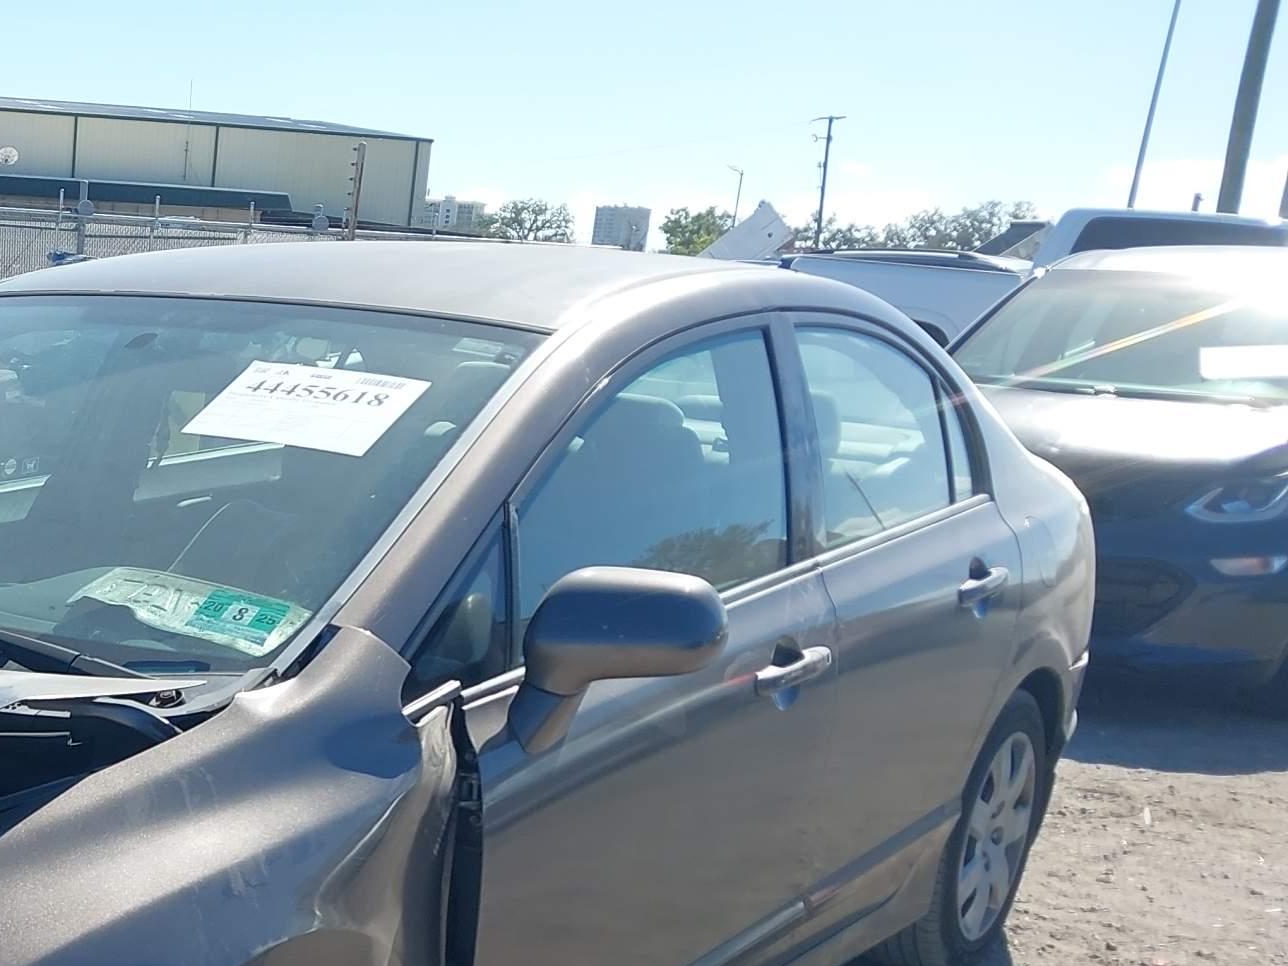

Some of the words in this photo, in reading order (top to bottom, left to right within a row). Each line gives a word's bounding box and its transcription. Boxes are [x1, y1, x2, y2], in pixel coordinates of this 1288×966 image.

[246, 379, 391, 408] 44455618
[203, 600, 225, 613] 20
[231, 607, 250, 622] 8
[254, 613, 277, 625] 25
